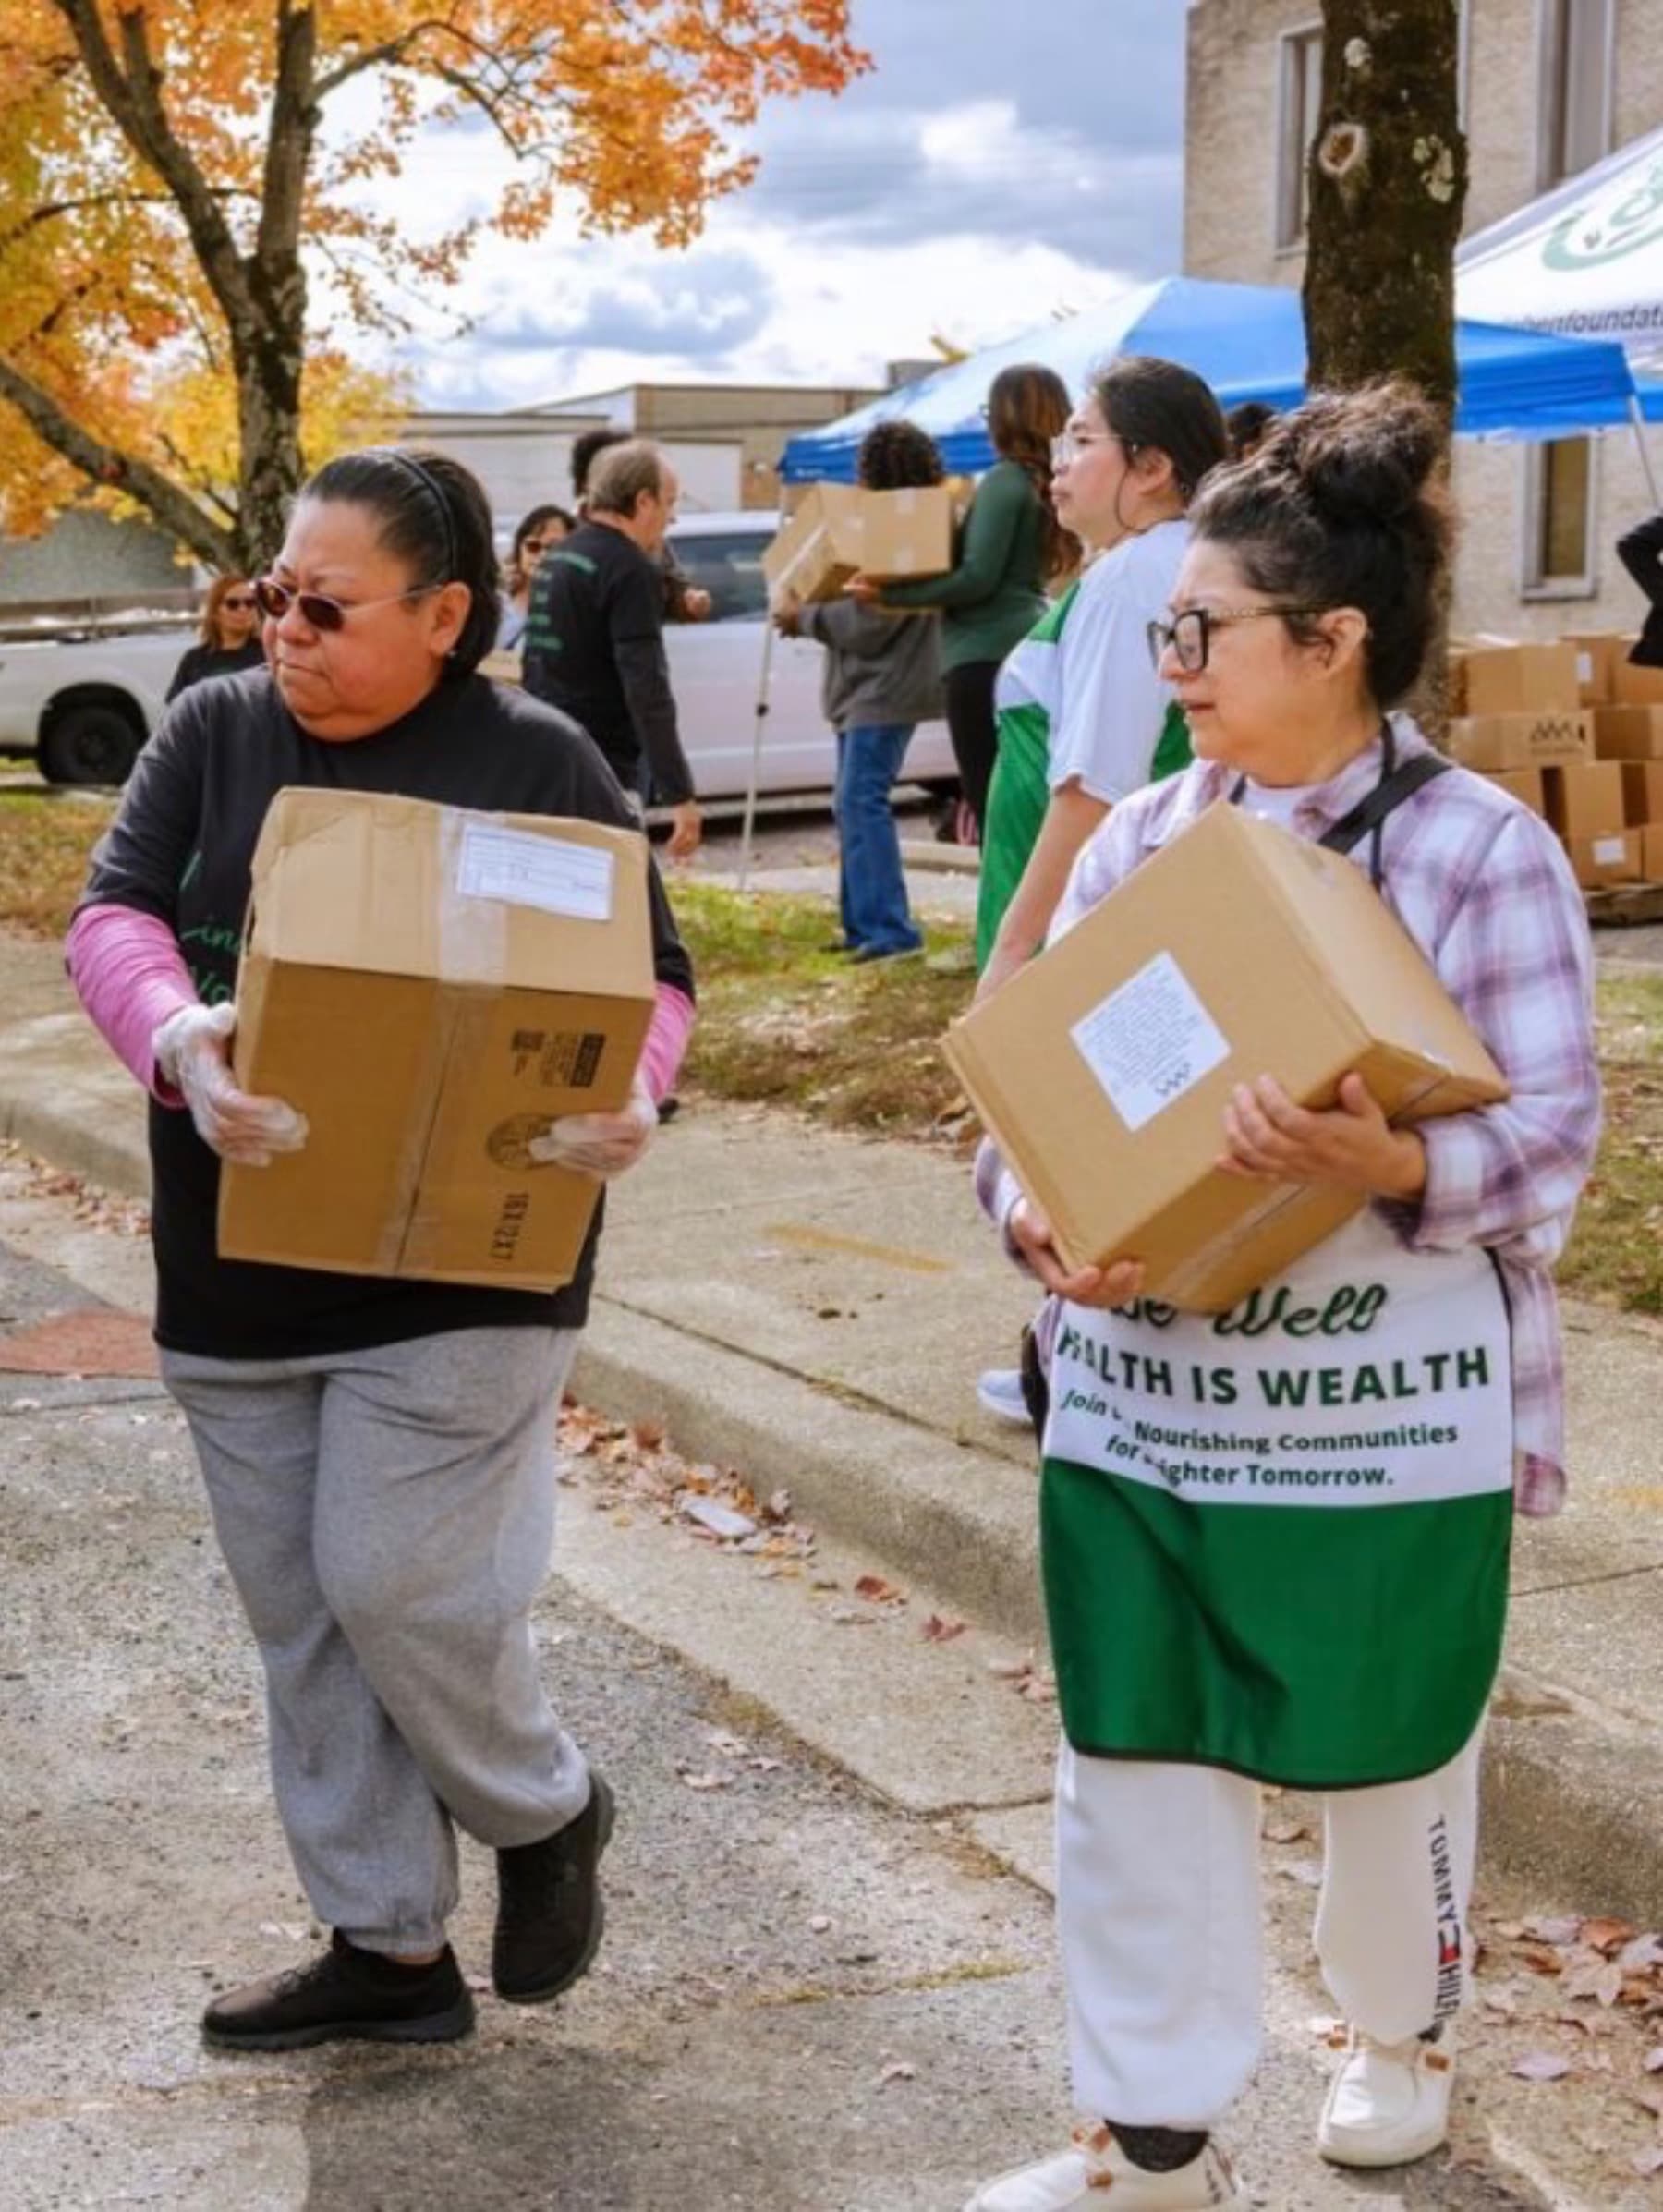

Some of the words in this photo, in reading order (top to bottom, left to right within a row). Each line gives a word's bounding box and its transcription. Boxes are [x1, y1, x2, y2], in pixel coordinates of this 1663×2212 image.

[1212, 1282, 1388, 1337] Well
[1191, 1365, 1238, 1405] IS
[1257, 1345, 1489, 1407] WEALTH
[1061, 1389, 1108, 1416] Join
[1135, 1419, 1272, 1456] Nourishing
[1277, 1424, 1458, 1452] Communities
[1105, 1434, 1140, 1461] for
[1246, 1464, 1394, 1487] Tomorrow.
[1428, 1815, 1457, 1924] TOMMY
